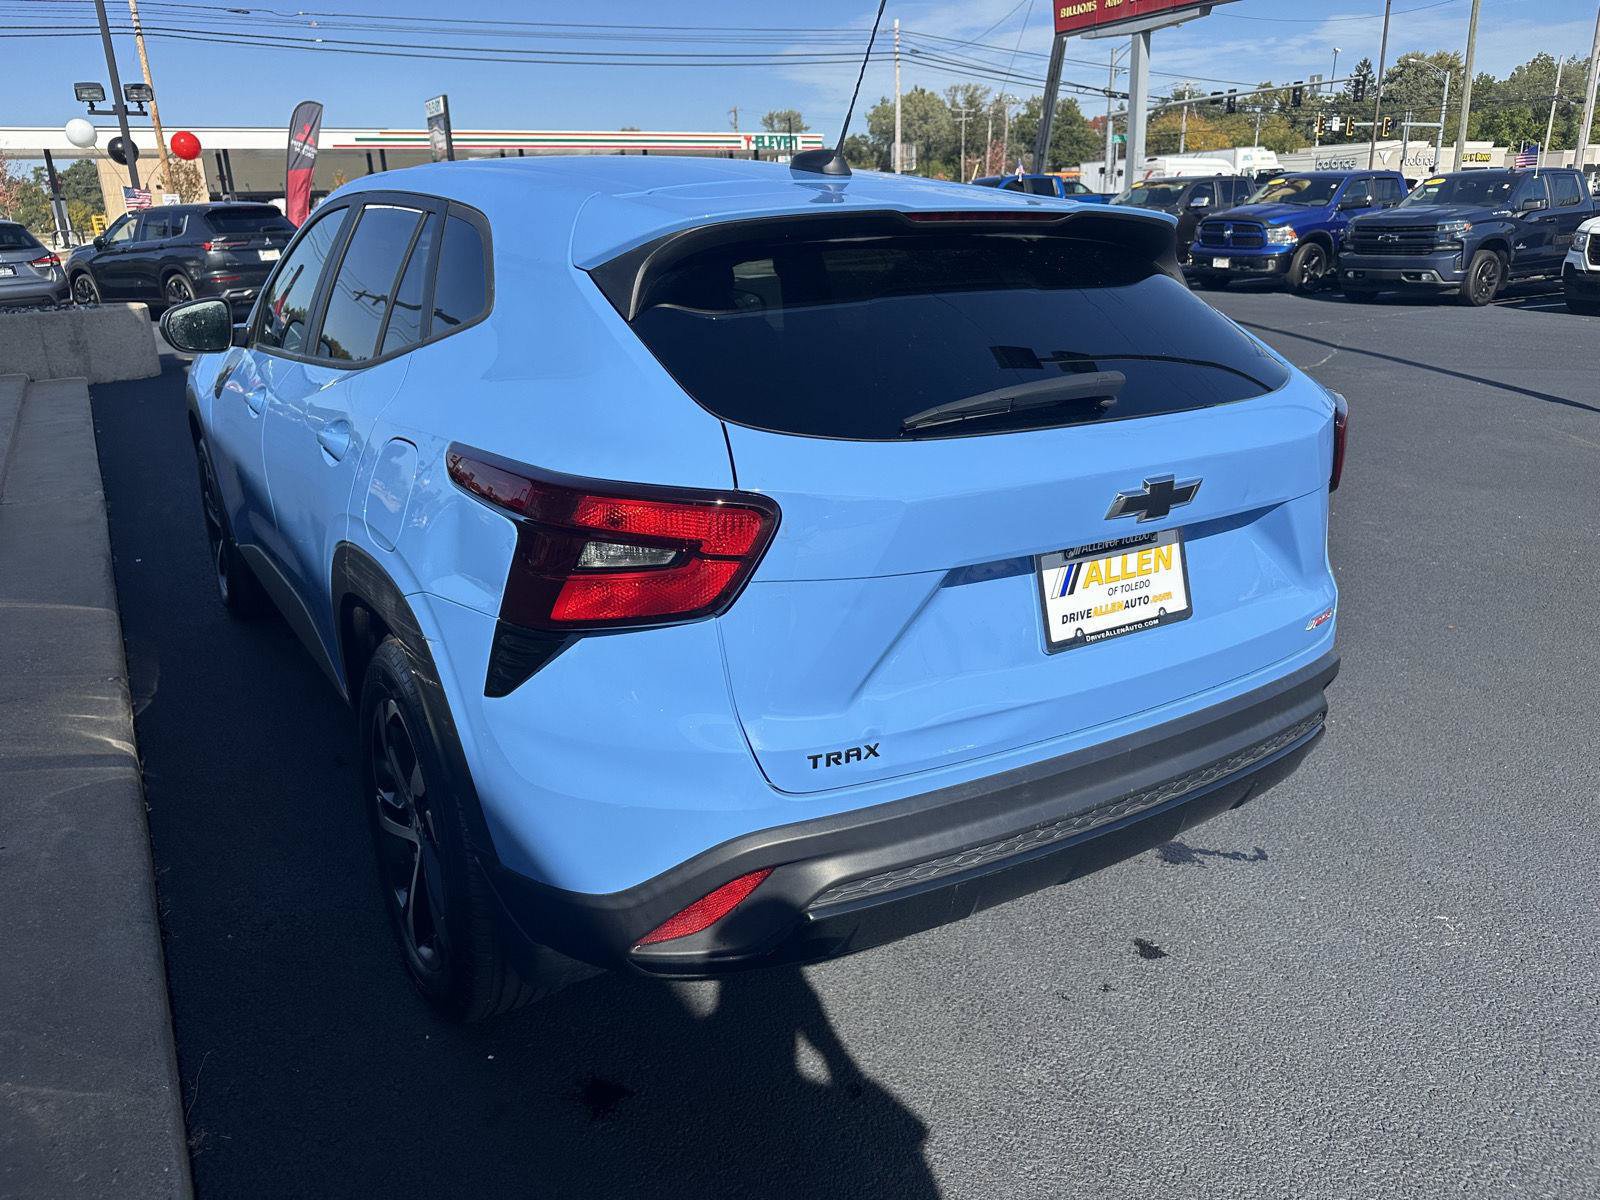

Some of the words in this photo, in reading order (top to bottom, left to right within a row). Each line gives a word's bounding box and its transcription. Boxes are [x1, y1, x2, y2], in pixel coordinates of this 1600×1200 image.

[1060, 1, 1097, 18] BILLIONS
[1083, 544, 1173, 589] ALLEN
[1107, 587, 1119, 597] OF
[1120, 579, 1151, 594] TOLEDO
[807, 742, 880, 770] TRAX
